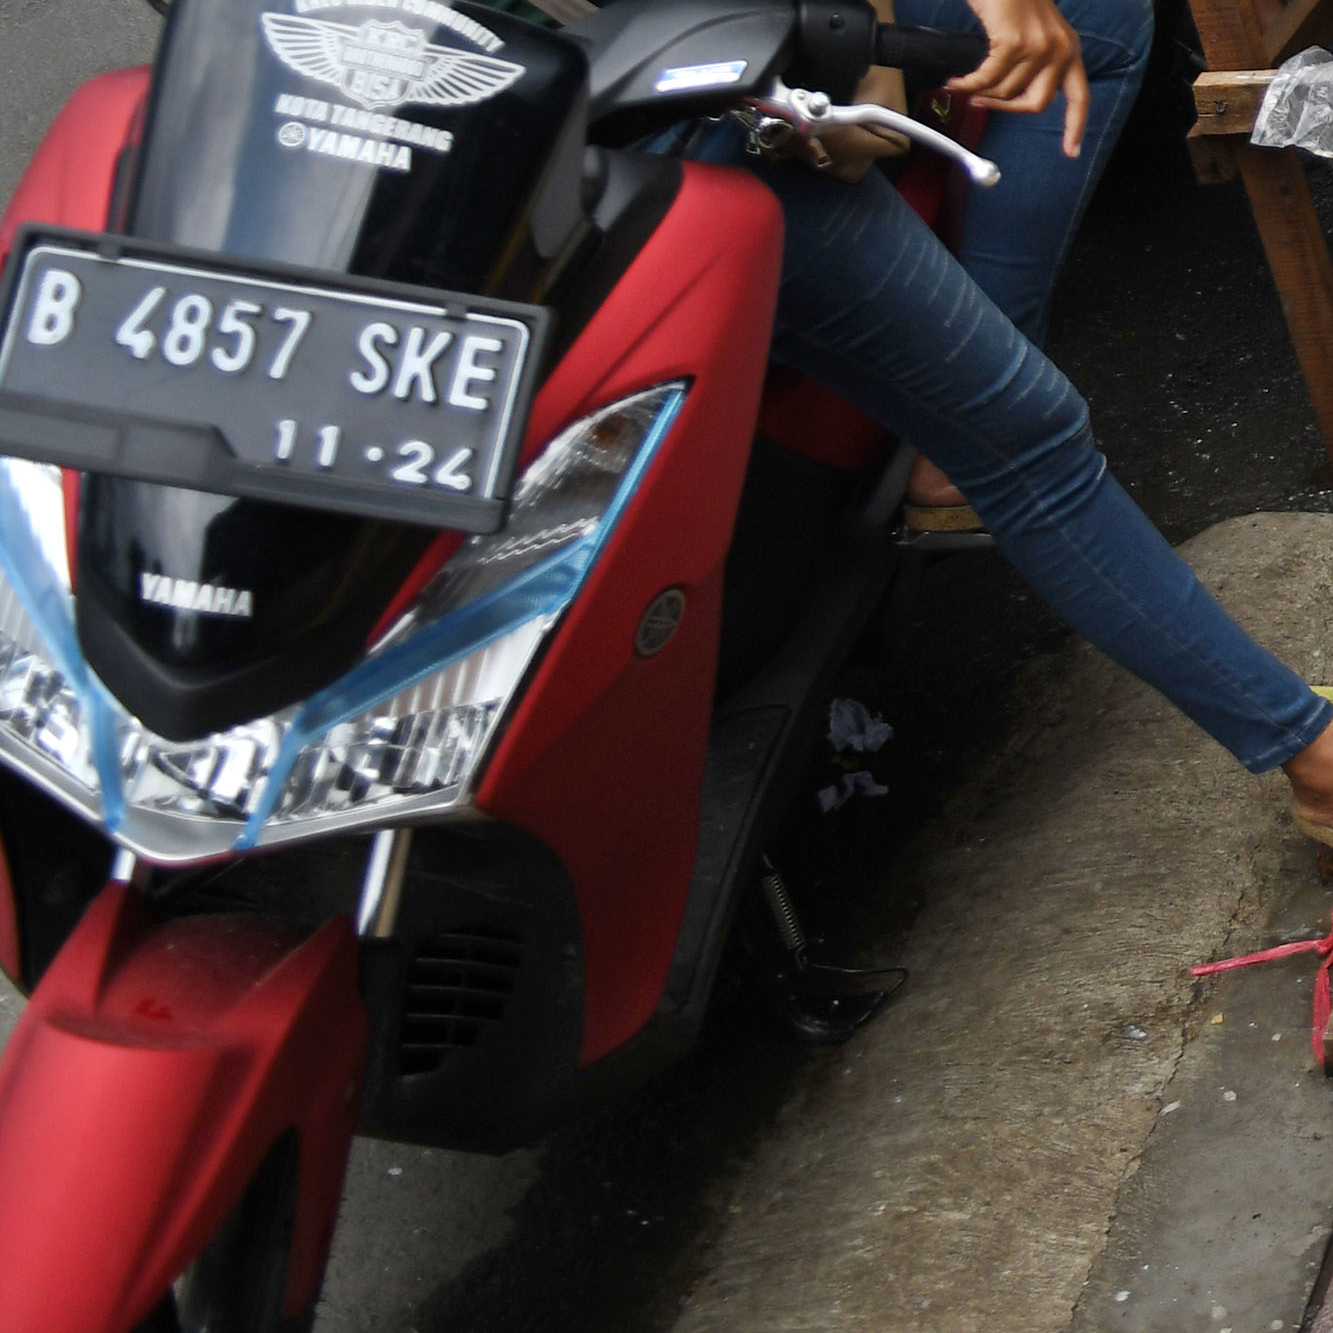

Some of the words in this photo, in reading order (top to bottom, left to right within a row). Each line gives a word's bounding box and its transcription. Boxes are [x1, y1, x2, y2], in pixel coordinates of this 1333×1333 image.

[275, 93, 329, 122] KOTA
[330, 104, 454, 153] TANGERANG
[307, 127, 412, 172] YAMAHA
[27, 268, 82, 346] B
[115, 286, 312, 380] 4857
[350, 322, 502, 410] SKE
[142, 572, 252, 617] YAMAHA
